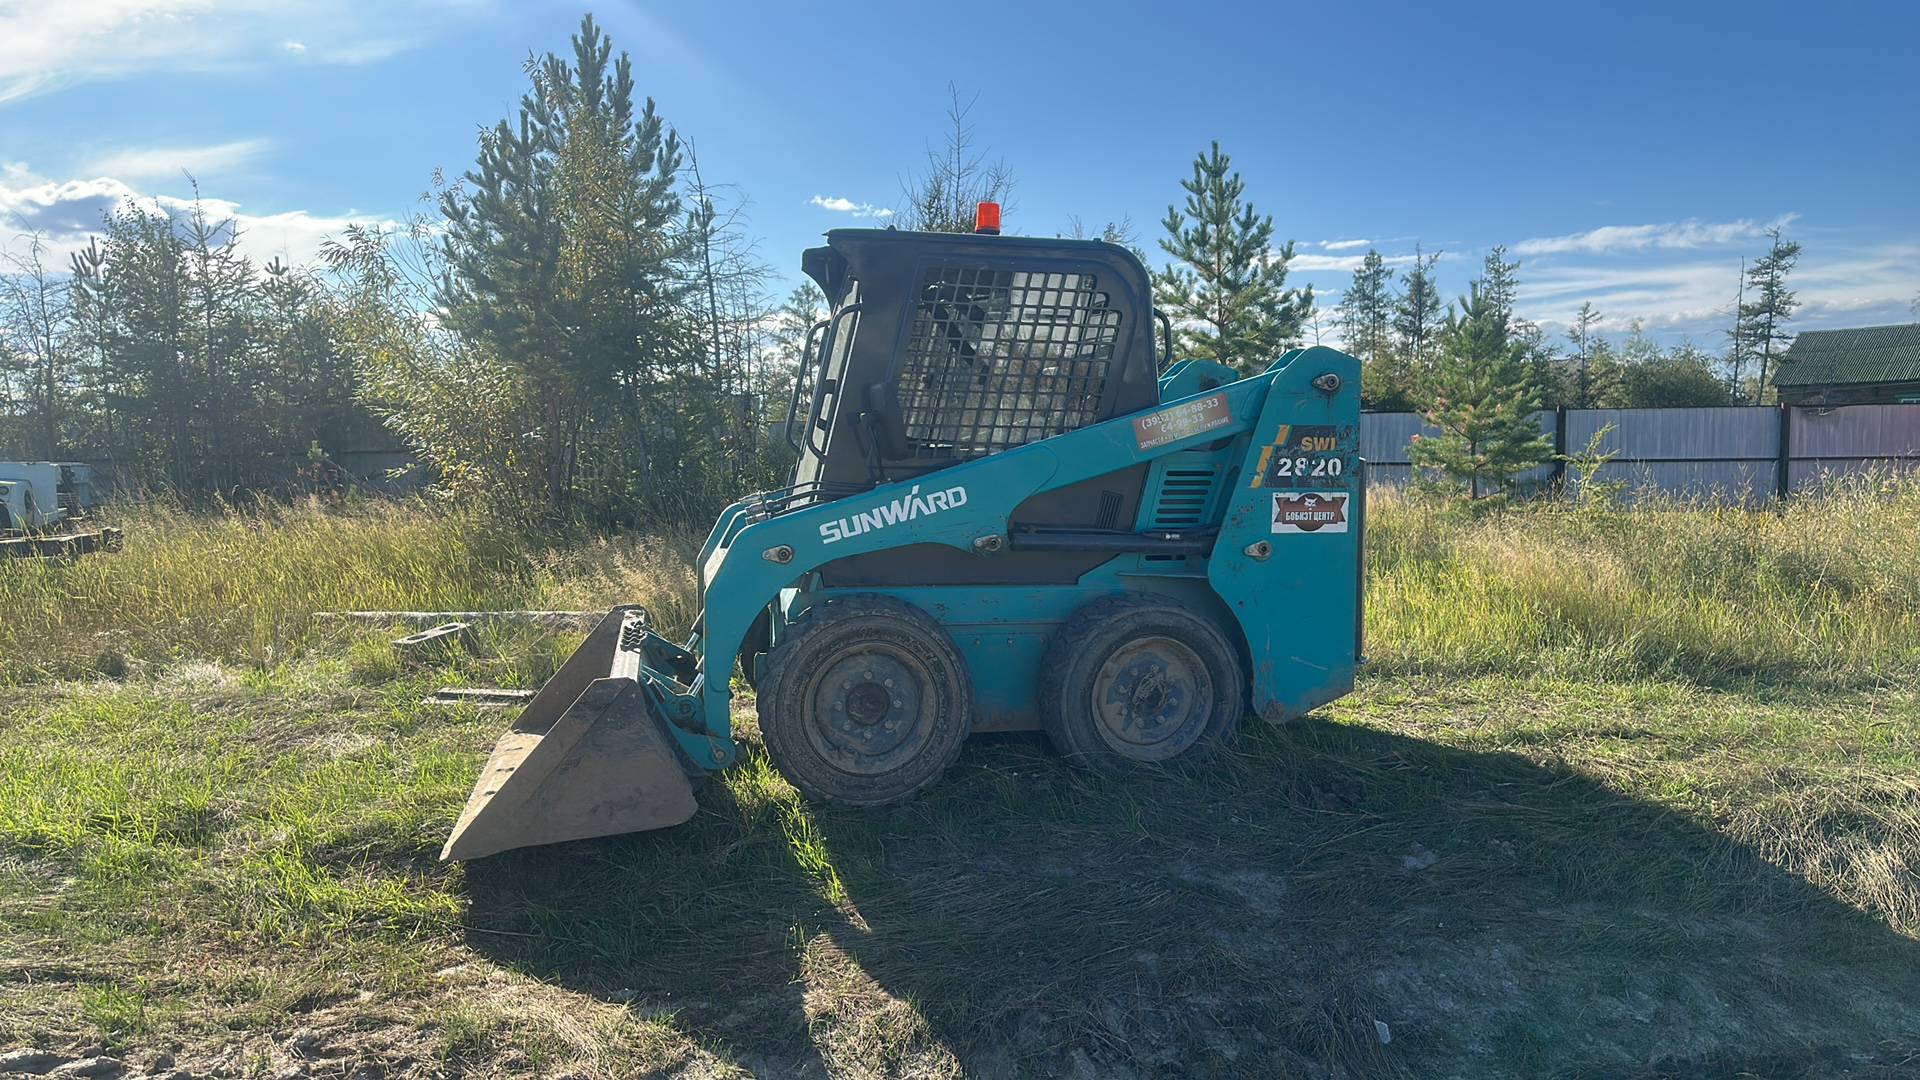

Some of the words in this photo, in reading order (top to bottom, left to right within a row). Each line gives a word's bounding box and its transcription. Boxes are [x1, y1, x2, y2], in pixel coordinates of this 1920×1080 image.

[1277, 457, 1342, 477] 2820
[819, 484, 968, 545] SUNWARD
[1313, 511, 1335, 522] ЦЕНТР
